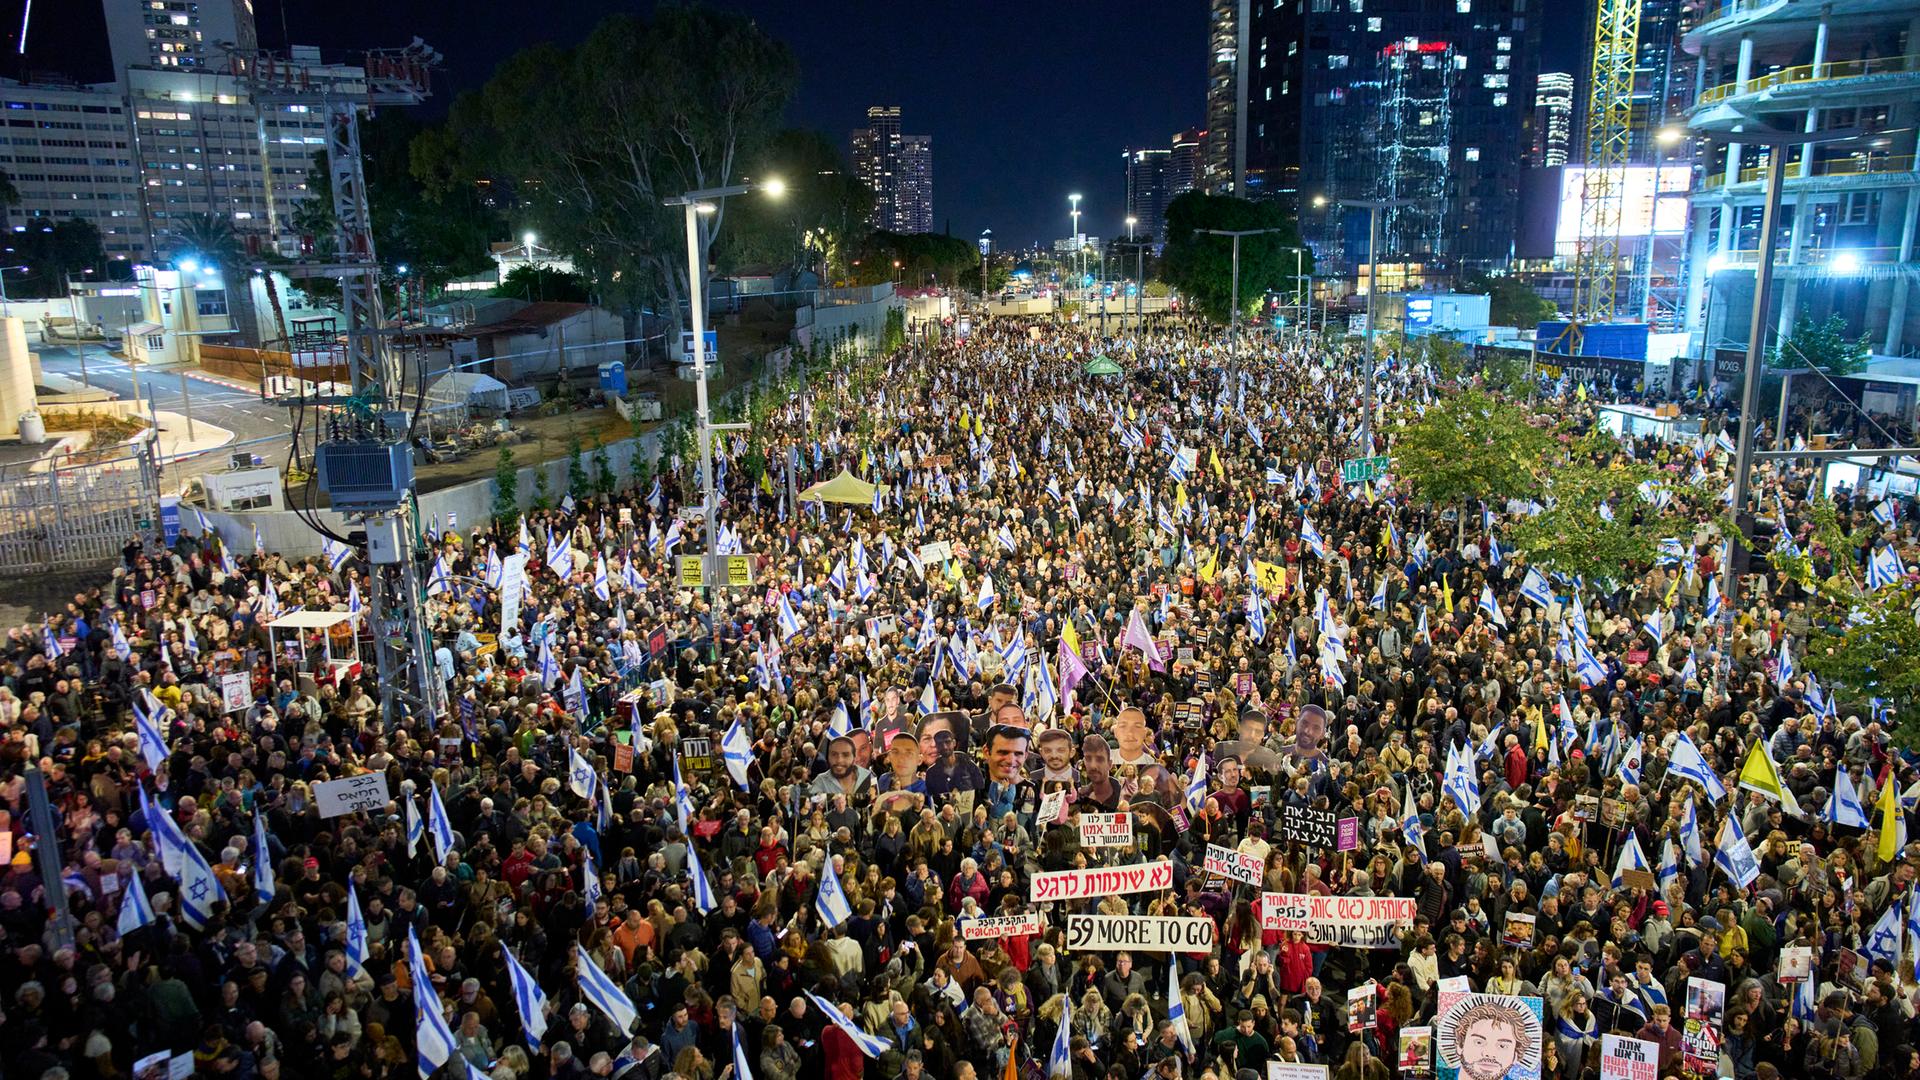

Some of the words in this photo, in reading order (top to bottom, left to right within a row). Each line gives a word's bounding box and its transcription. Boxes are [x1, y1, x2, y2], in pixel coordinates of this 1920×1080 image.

[684, 740, 709, 757] כולם
[349, 776, 377, 788] ביבי
[1283, 805, 1304, 818] את
[1306, 806, 1336, 824] תציל
[1087, 814, 1100, 823] לנו
[1103, 814, 1114, 823] יש
[1082, 824, 1104, 835] אמון
[1108, 824, 1129, 834] חוסר
[1285, 816, 1335, 836] המדינה
[1085, 834, 1096, 846] בך
[1100, 834, 1129, 845] מתמשך
[1283, 826, 1333, 847] מעצמך
[1207, 846, 1225, 861] תהיה
[1226, 852, 1238, 863] לא
[1149, 863, 1172, 888] לא
[1036, 872, 1079, 898] לרגע
[1083, 869, 1146, 896] שוכחות
[1265, 895, 1288, 906] מחר
[1276, 907, 1307, 919] כולם
[1338, 897, 1364, 920] כגוש
[1020, 923, 1036, 935] את
[1068, 917, 1094, 947] 59
[1097, 919, 1151, 944] MORE
[1156, 920, 1182, 945] TO
[1185, 921, 1212, 946] GO
[1338, 924, 1357, 945] את
[1618, 1039, 1641, 1052] אתה
[1614, 1047, 1645, 1062] הראש
[1603, 1055, 1629, 1068] אשם
[1632, 1060, 1655, 1073] אתה
